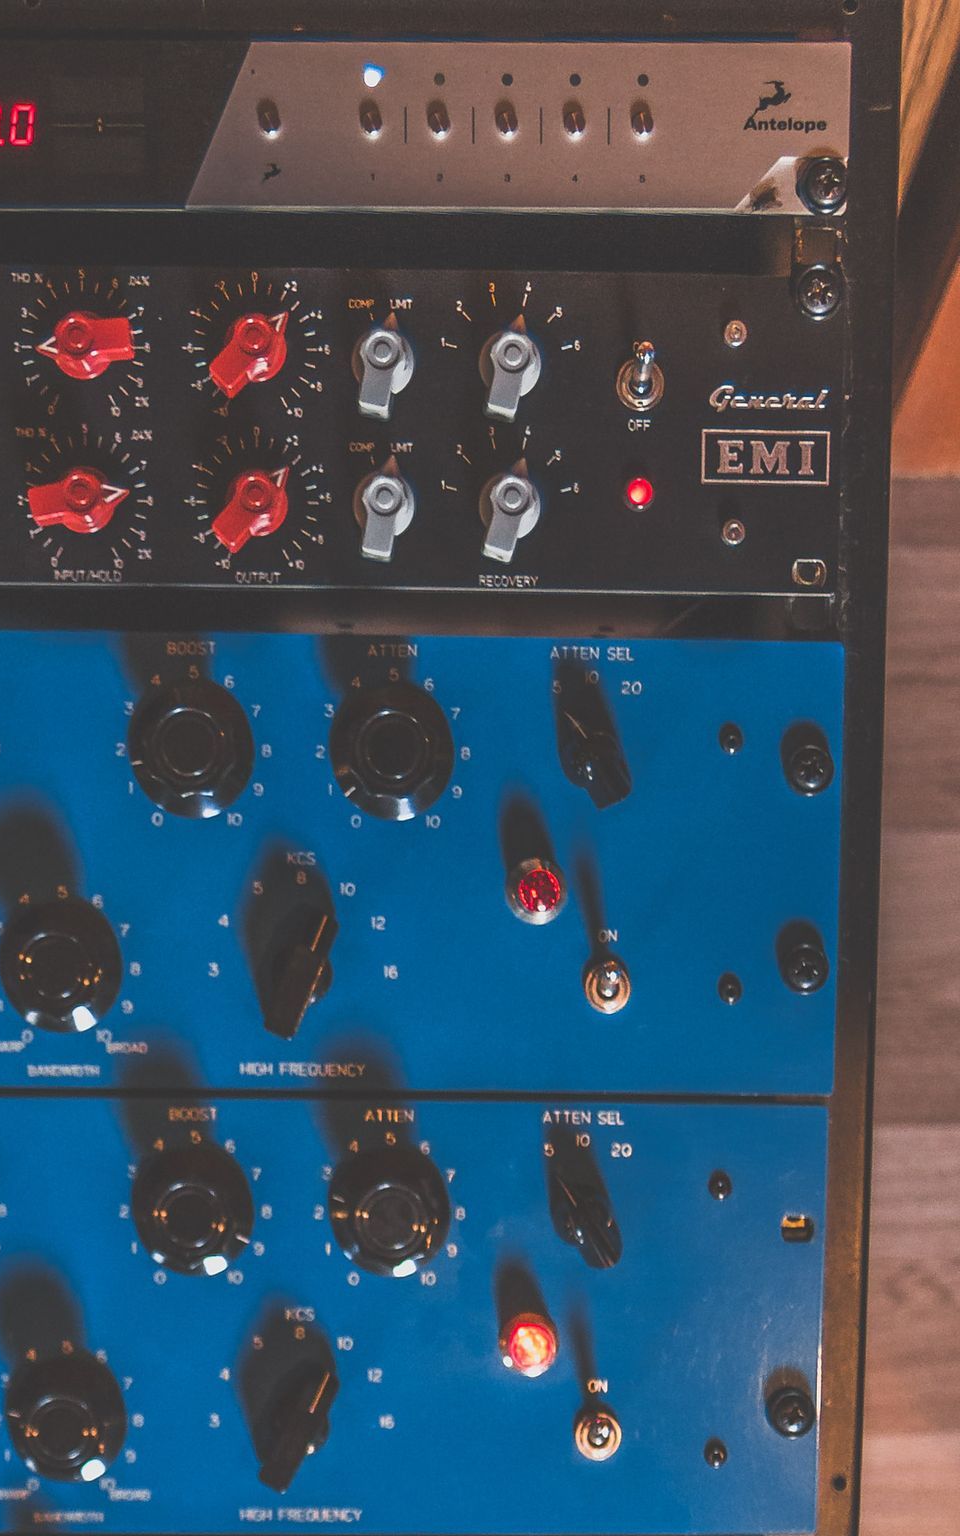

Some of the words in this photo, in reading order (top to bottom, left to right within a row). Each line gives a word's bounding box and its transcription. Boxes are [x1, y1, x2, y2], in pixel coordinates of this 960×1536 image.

[743, 116, 827, 134] Antelope
[348, 299, 374, 310] COMP
[709, 385, 829, 413] General
[628, 419, 651, 432] OFF
[716, 440, 815, 475] EMI
[235, 571, 281, 584] OUTPUT
[478, 574, 539, 587] RECOVERY
[166, 640, 216, 655] BOOST
[367, 644, 418, 658] ATTEN
[550, 646, 600, 661] ATTEN
[607, 647, 634, 661] SEL
[224, 674, 235, 689] 6
[585, 670, 599, 684] 10
[552, 680, 561, 695] 5
[621, 681, 642, 695] 20
[115, 743, 126, 757] 2
[261, 743, 273, 758] 8
[253, 783, 264, 797] 9
[227, 812, 243, 827] 10
[287, 852, 316, 866] KCS
[253, 881, 264, 895] 5
[340, 882, 356, 897] 10
[371, 916, 386, 931] 12
[598, 929, 618, 943] ON
[208, 961, 219, 977] 3
[383, 965, 398, 980] 16
[240, 1062, 273, 1077] HIGH
[279, 1062, 365, 1077] FREQUENCY
[168, 1107, 216, 1121] BOOST
[364, 1109, 414, 1123] ATTEN
[543, 1110, 591, 1125] ATTEN
[598, 1111, 624, 1125] SEL
[576, 1134, 590, 1147] 10
[544, 1144, 555, 1157] 5
[611, 1143, 632, 1158] 20
[285, 1307, 315, 1322] KCS
[337, 1336, 353, 1350] 10
[219, 1367, 230, 1382] 4
[367, 1368, 383, 1383] 12
[588, 1379, 608, 1393] ON
[209, 1412, 220, 1428] 3
[379, 1414, 395, 1429] 16
[240, 1508, 273, 1522] HIGH
[278, 1508, 362, 1522] FREQUENCY
